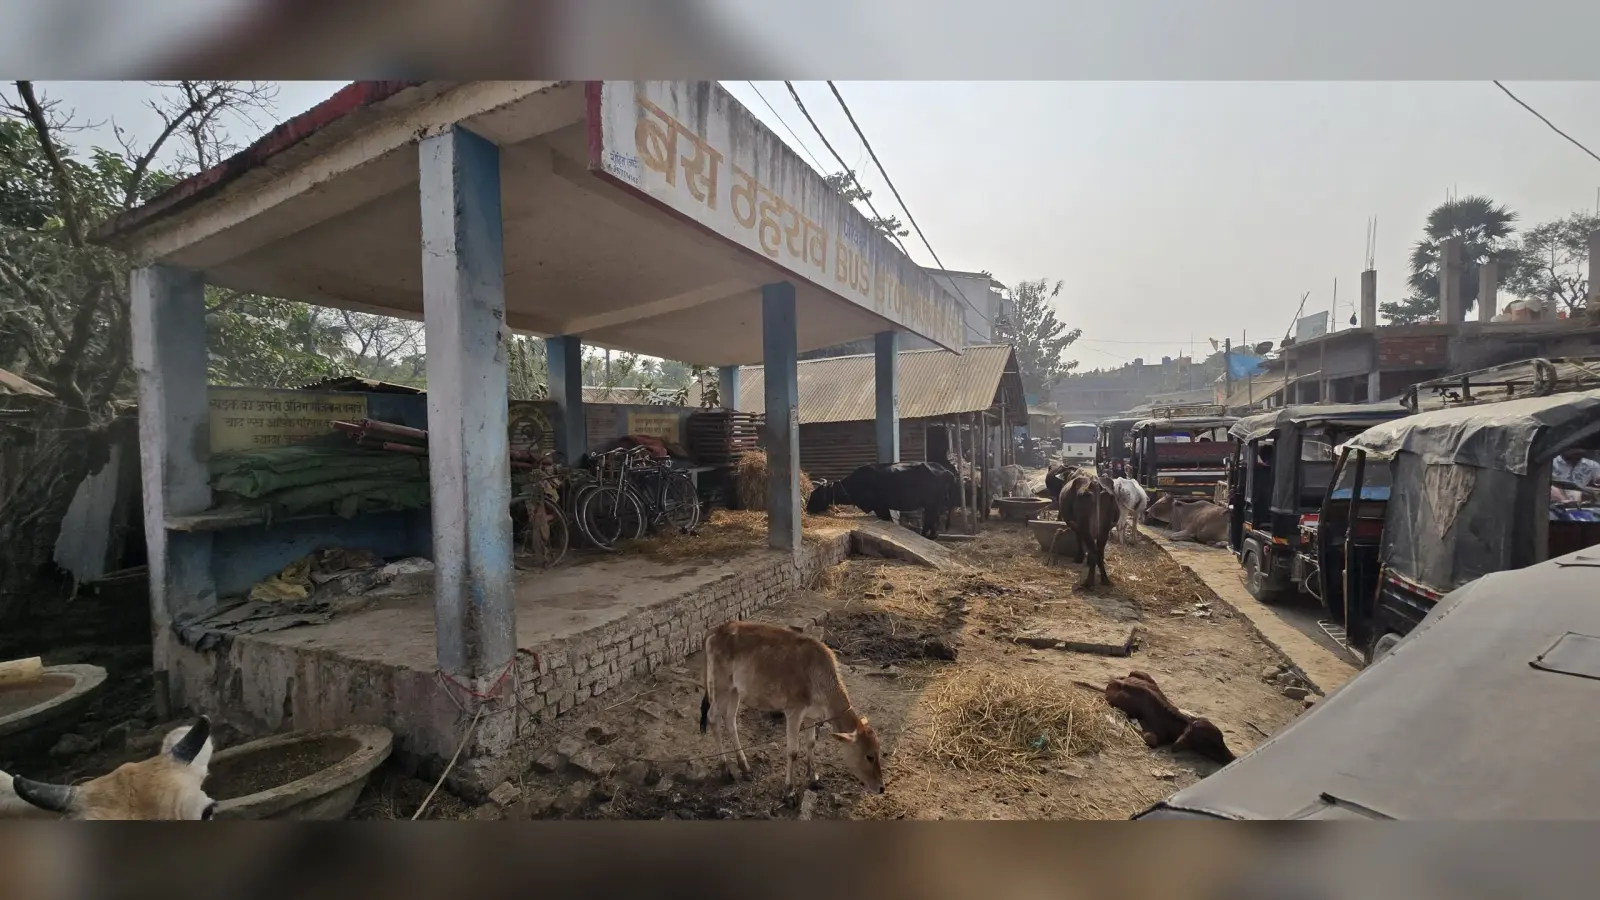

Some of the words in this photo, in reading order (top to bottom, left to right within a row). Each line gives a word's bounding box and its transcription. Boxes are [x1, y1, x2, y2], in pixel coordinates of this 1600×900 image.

[635, 96, 723, 209] बस
[732, 162, 829, 273] ठहराव
[836, 240, 870, 296] BUS
